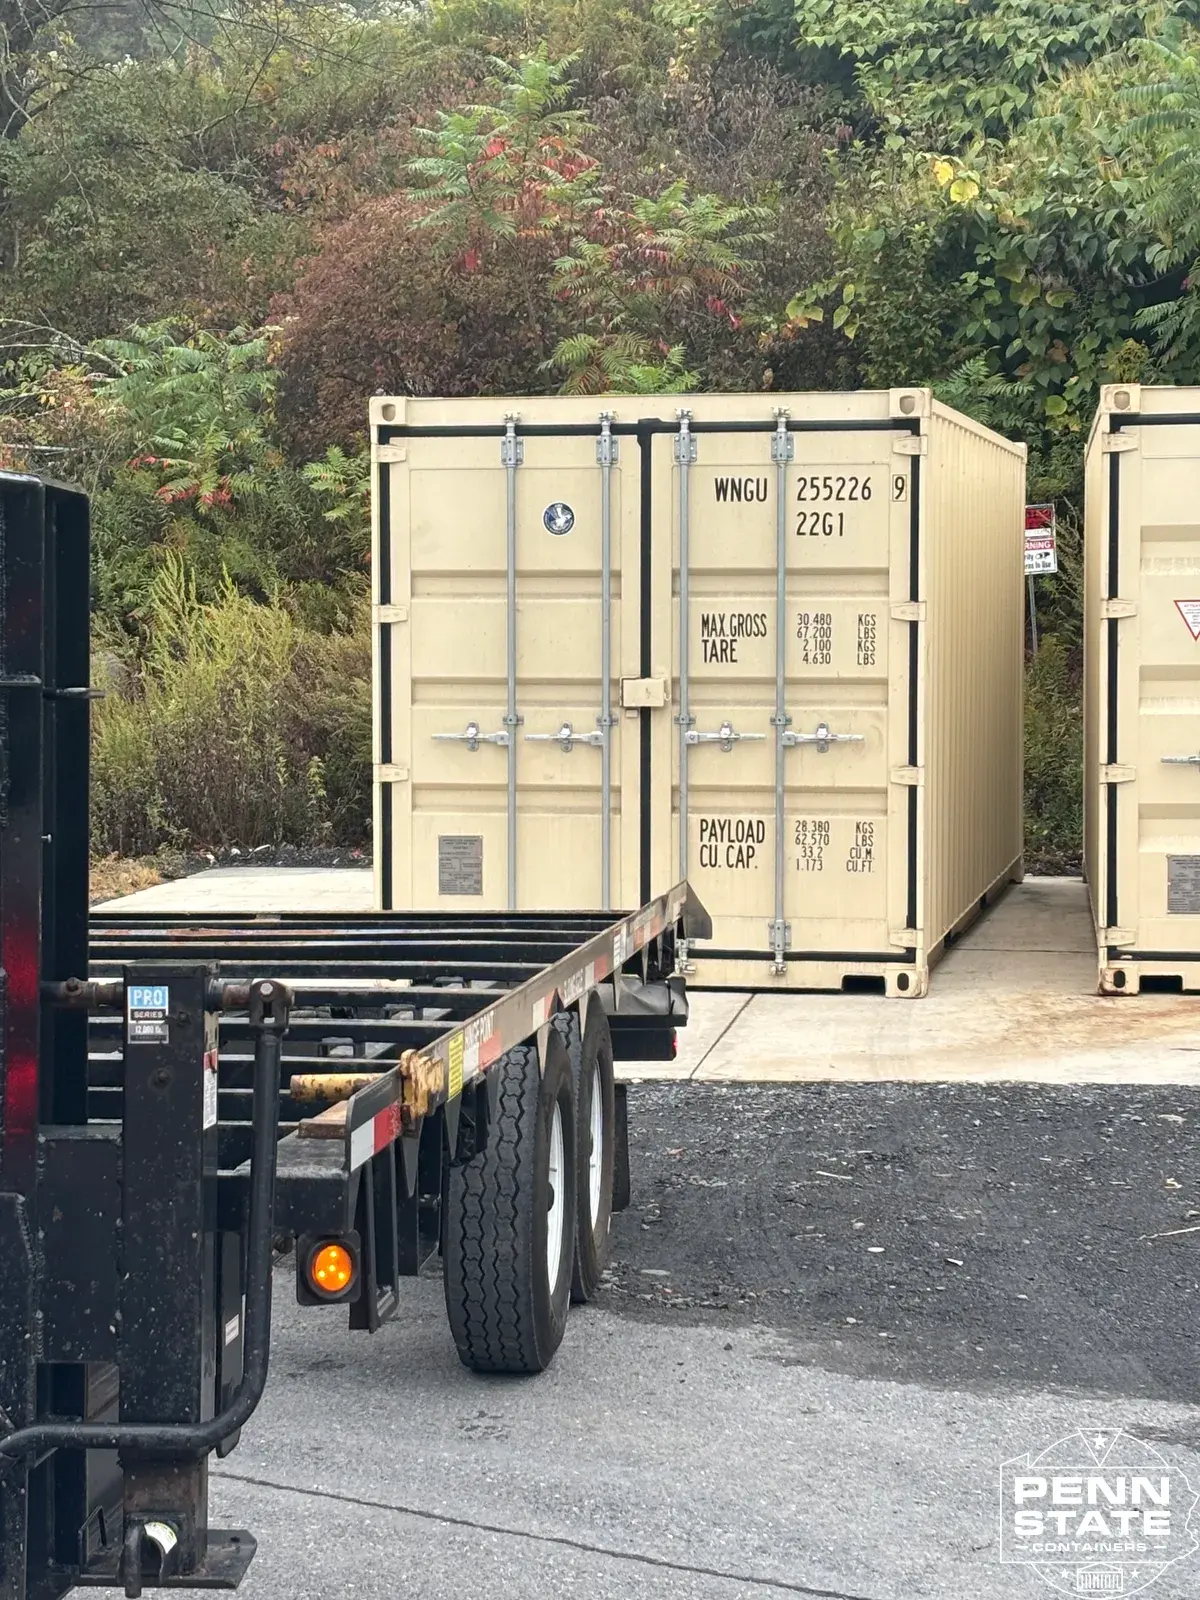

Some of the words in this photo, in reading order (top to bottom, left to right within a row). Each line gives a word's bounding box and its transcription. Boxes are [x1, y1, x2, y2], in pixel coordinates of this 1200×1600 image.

[715, 478, 768, 502] WNGU
[797, 477, 872, 501] 255226
[894, 476, 905, 500] 9
[796, 512, 844, 536] 22G1
[701, 613, 767, 638] MAX.GROSS
[797, 613, 832, 626] 30.480
[857, 614, 876, 627] KGS
[796, 626, 832, 639] 67.200
[857, 627, 876, 639] LBS
[701, 639, 738, 663] TARE
[803, 639, 832, 652] 2.100
[857, 640, 876, 652] KGS
[802, 652, 831, 665] 4.630
[857, 653, 876, 665] LBS
[699, 819, 765, 844] PAYLOAD
[795, 820, 830, 833] 28.380
[855, 821, 874, 834] KGS
[795, 833, 830, 846] 62.570
[855, 835, 874, 847] LBS
[801, 846, 823, 859] 33.2
[133, 989, 163, 1006] PRO
